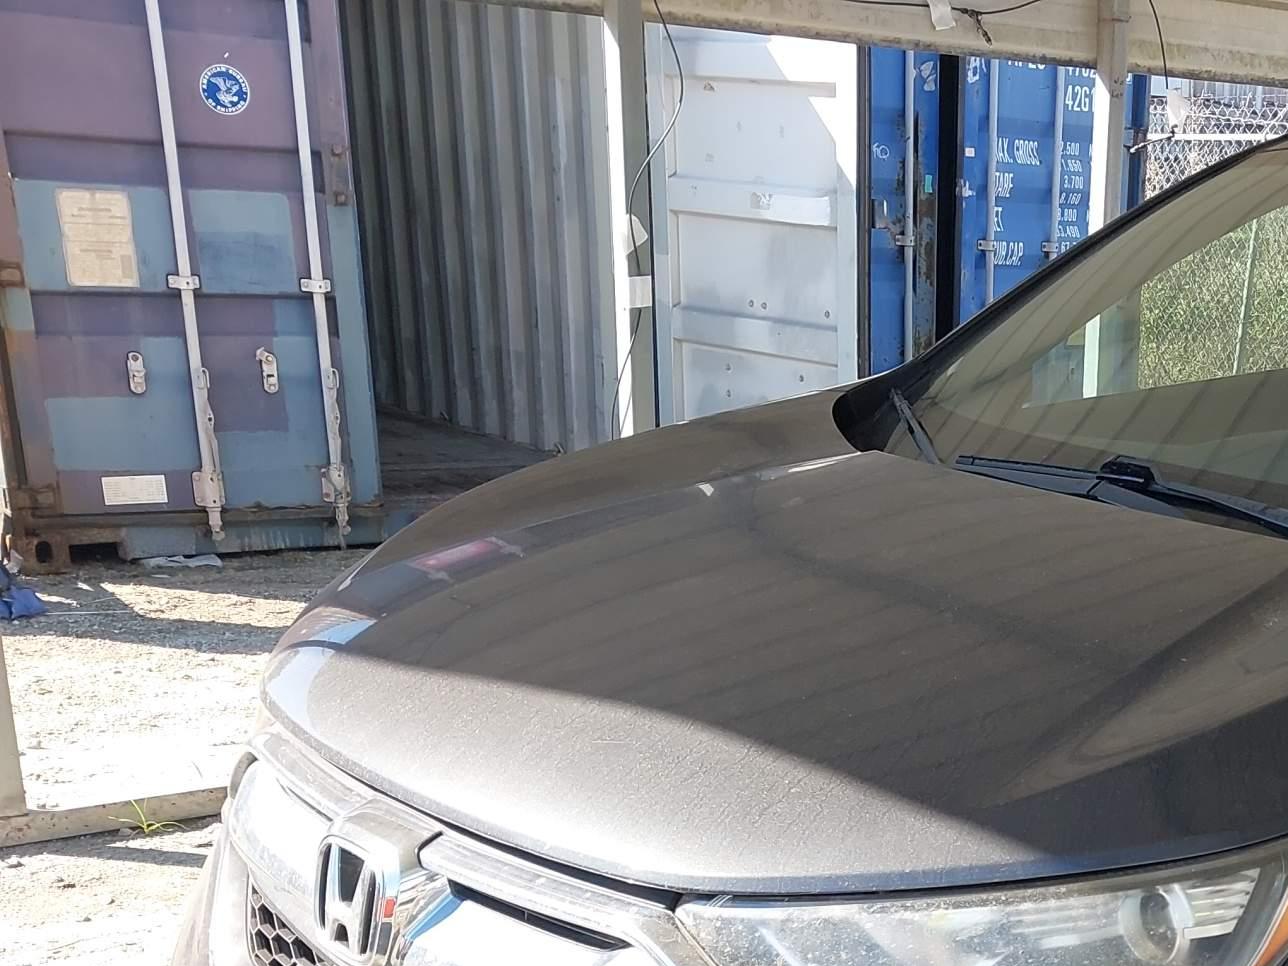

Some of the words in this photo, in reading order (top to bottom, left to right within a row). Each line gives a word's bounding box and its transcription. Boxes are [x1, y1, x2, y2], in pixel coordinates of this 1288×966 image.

[995, 137, 1014, 163] AX.
[1014, 139, 1040, 166] GROSS
[994, 171, 1014, 198] TARE
[1063, 174, 1084, 189] 3.700
